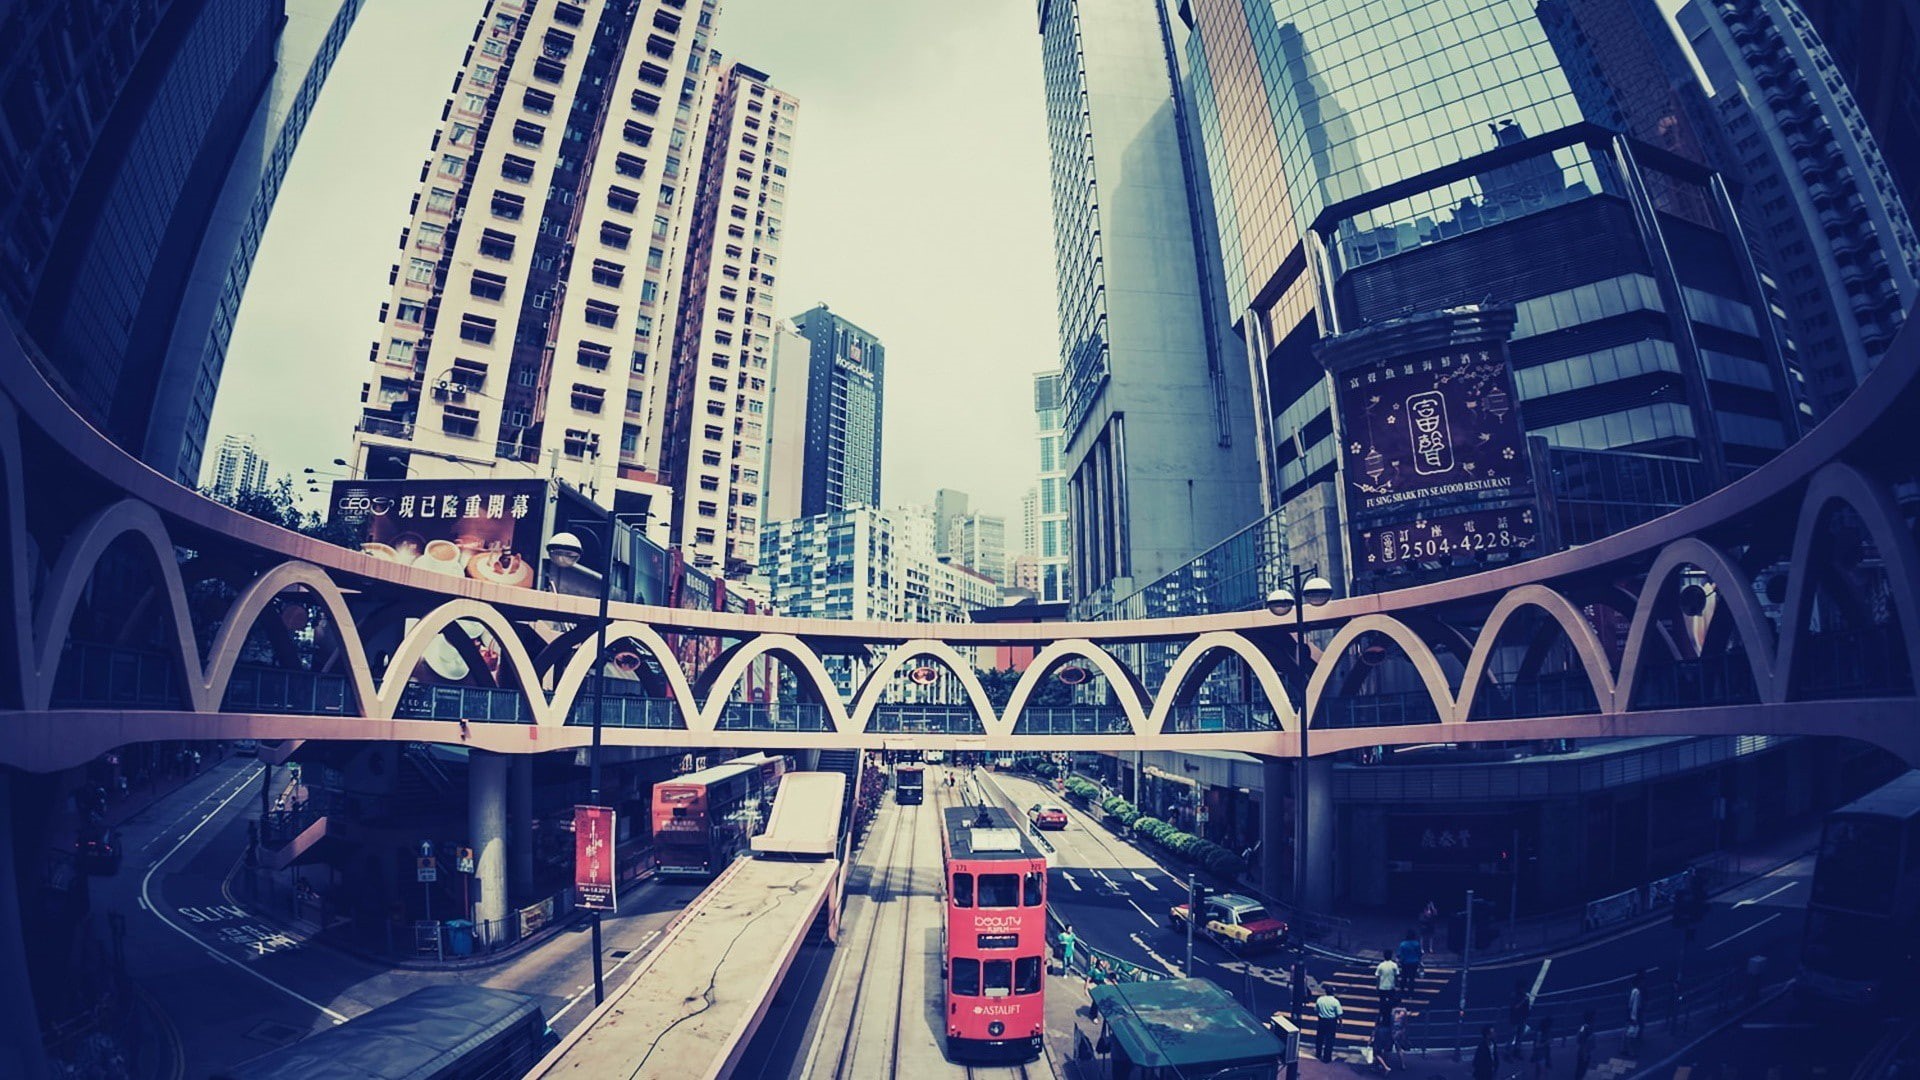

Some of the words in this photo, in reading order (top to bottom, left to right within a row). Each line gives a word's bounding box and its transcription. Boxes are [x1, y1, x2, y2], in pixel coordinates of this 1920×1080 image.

[1366, 498, 1376, 508] FU
[1376, 495, 1392, 505] SING
[1393, 490, 1416, 502] SHARK
[1417, 488, 1430, 498] FIN
[1430, 482, 1464, 496] SEAFOOD
[1464, 476, 1511, 491] RESTAURANT
[338, 497, 370, 509] CEO
[399, 494, 530, 519] 現已隆重開幕
[983, 1004, 1021, 1015] ASTALIFT
